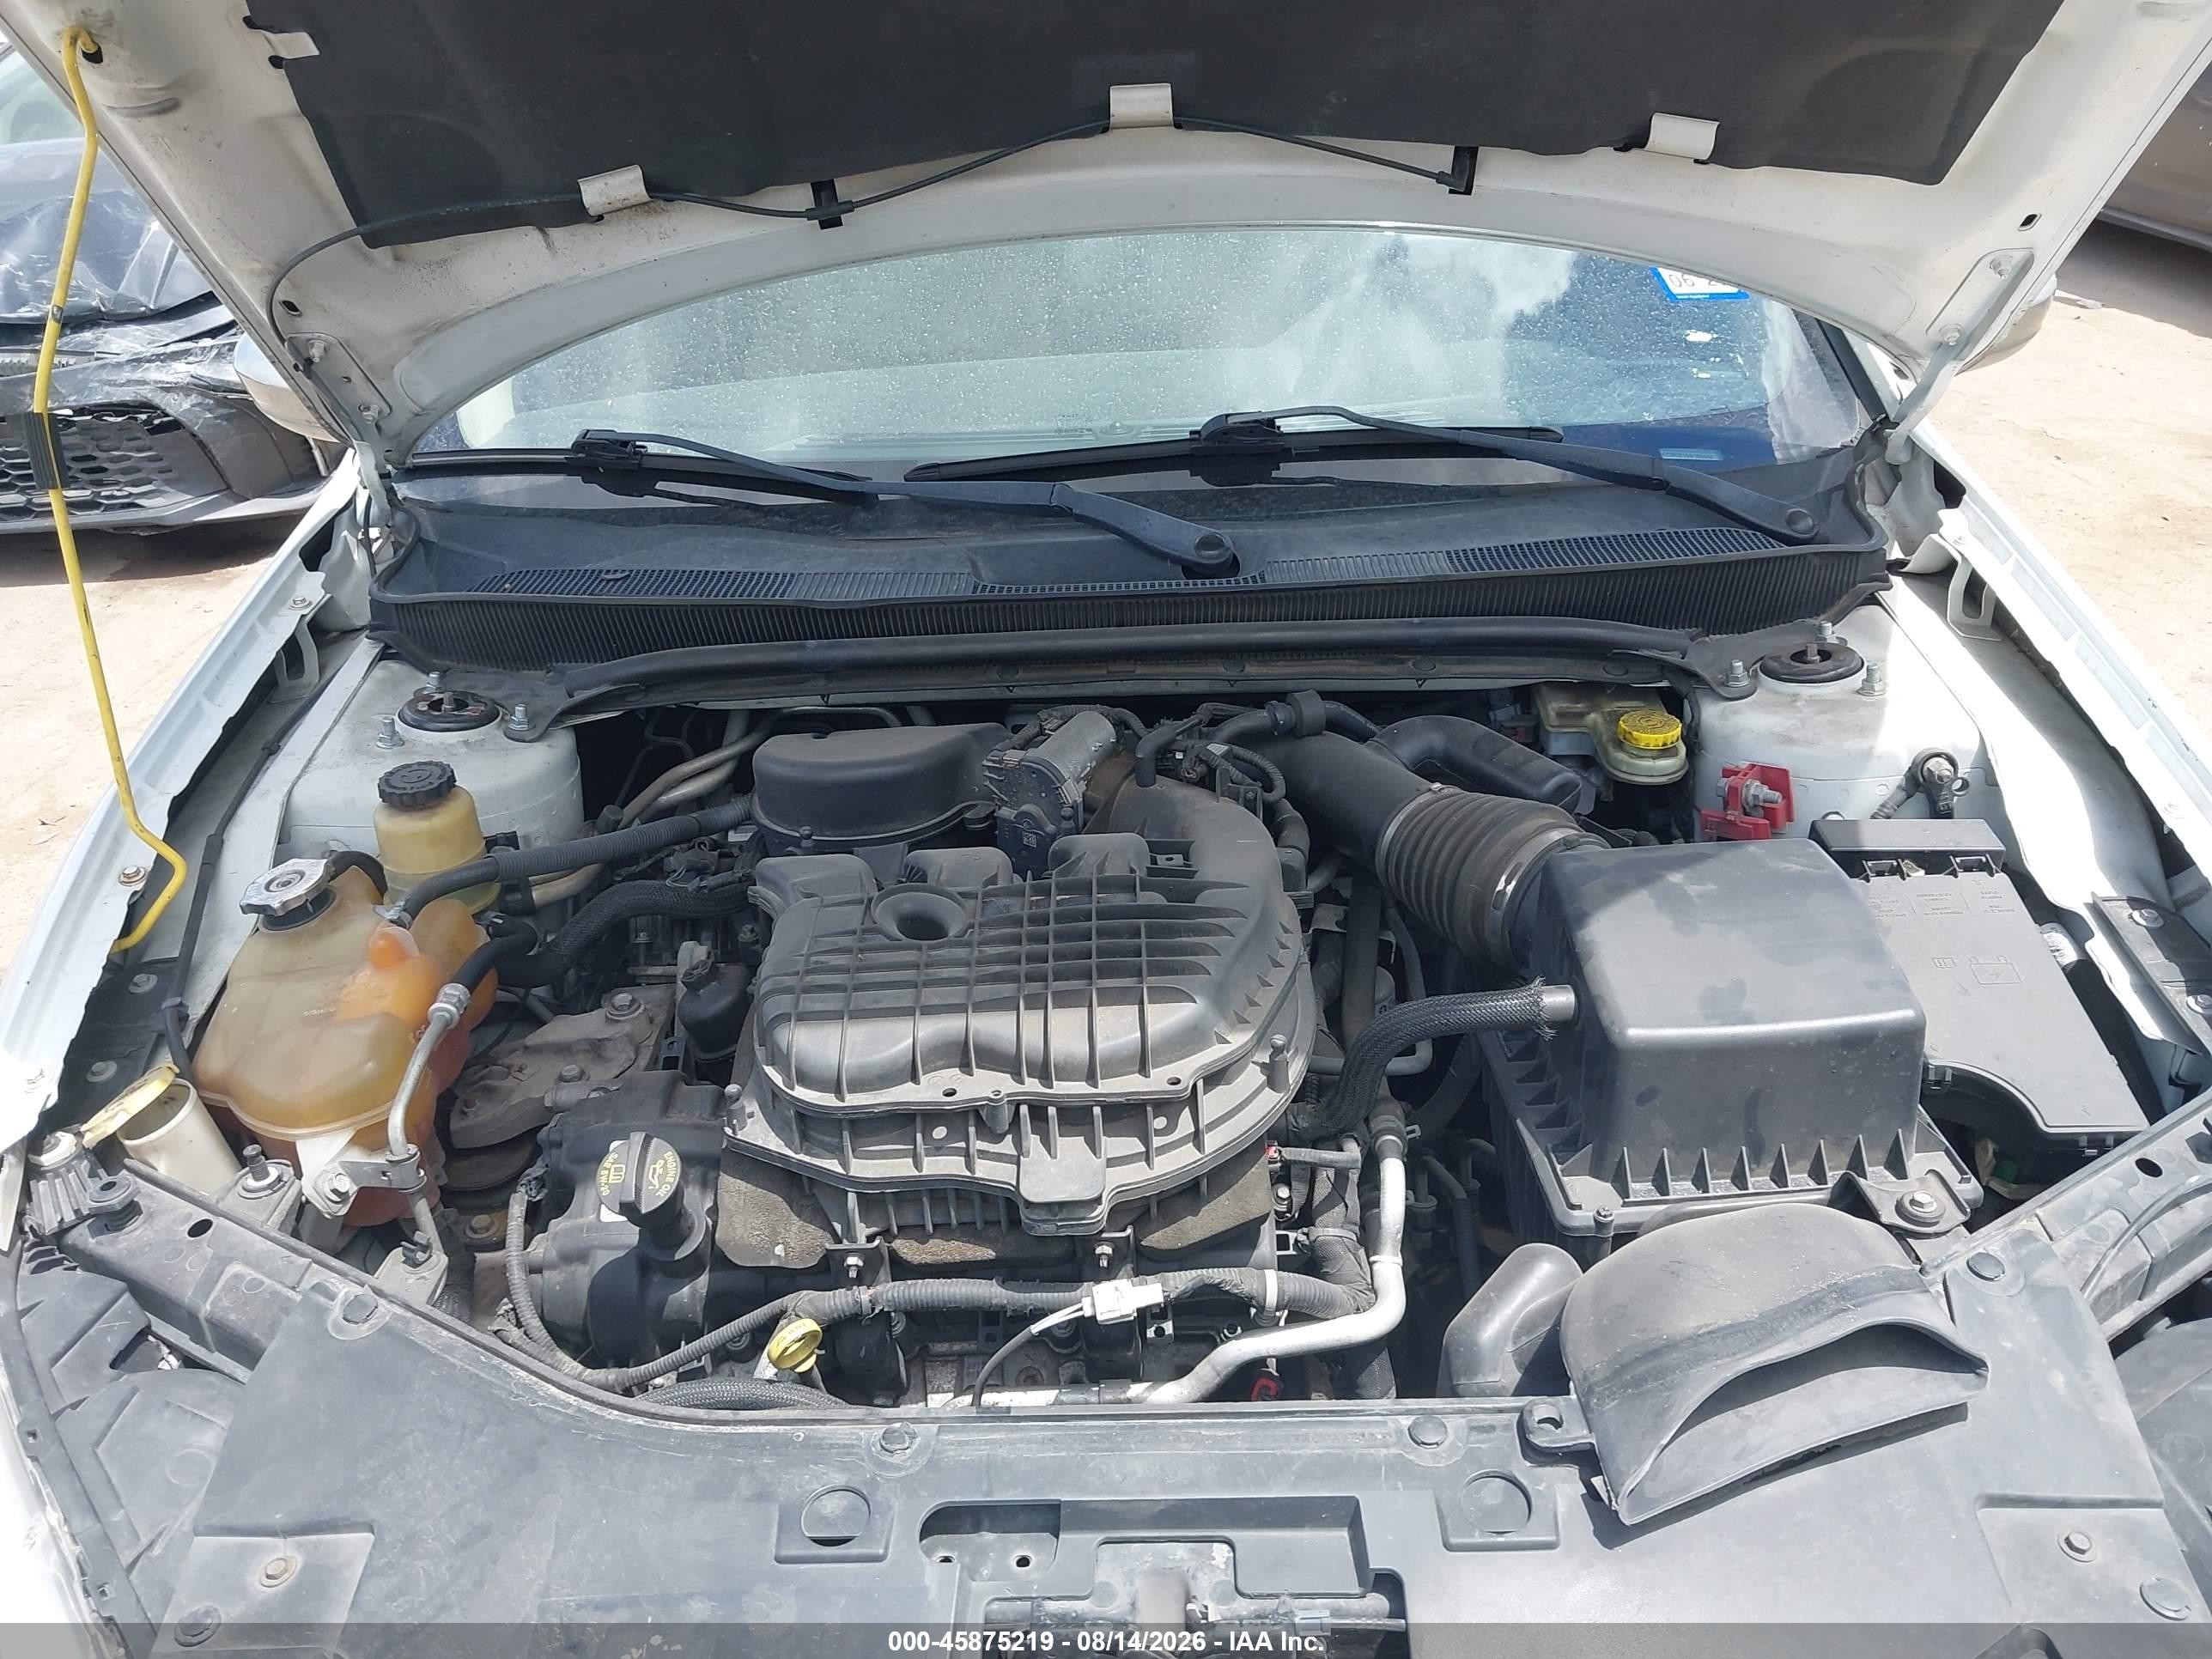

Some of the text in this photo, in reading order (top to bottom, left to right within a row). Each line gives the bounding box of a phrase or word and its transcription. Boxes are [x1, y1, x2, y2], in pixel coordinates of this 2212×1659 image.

[604, 1152, 619, 1169] SAE
[655, 1152, 678, 1197] ENGINE OIL
